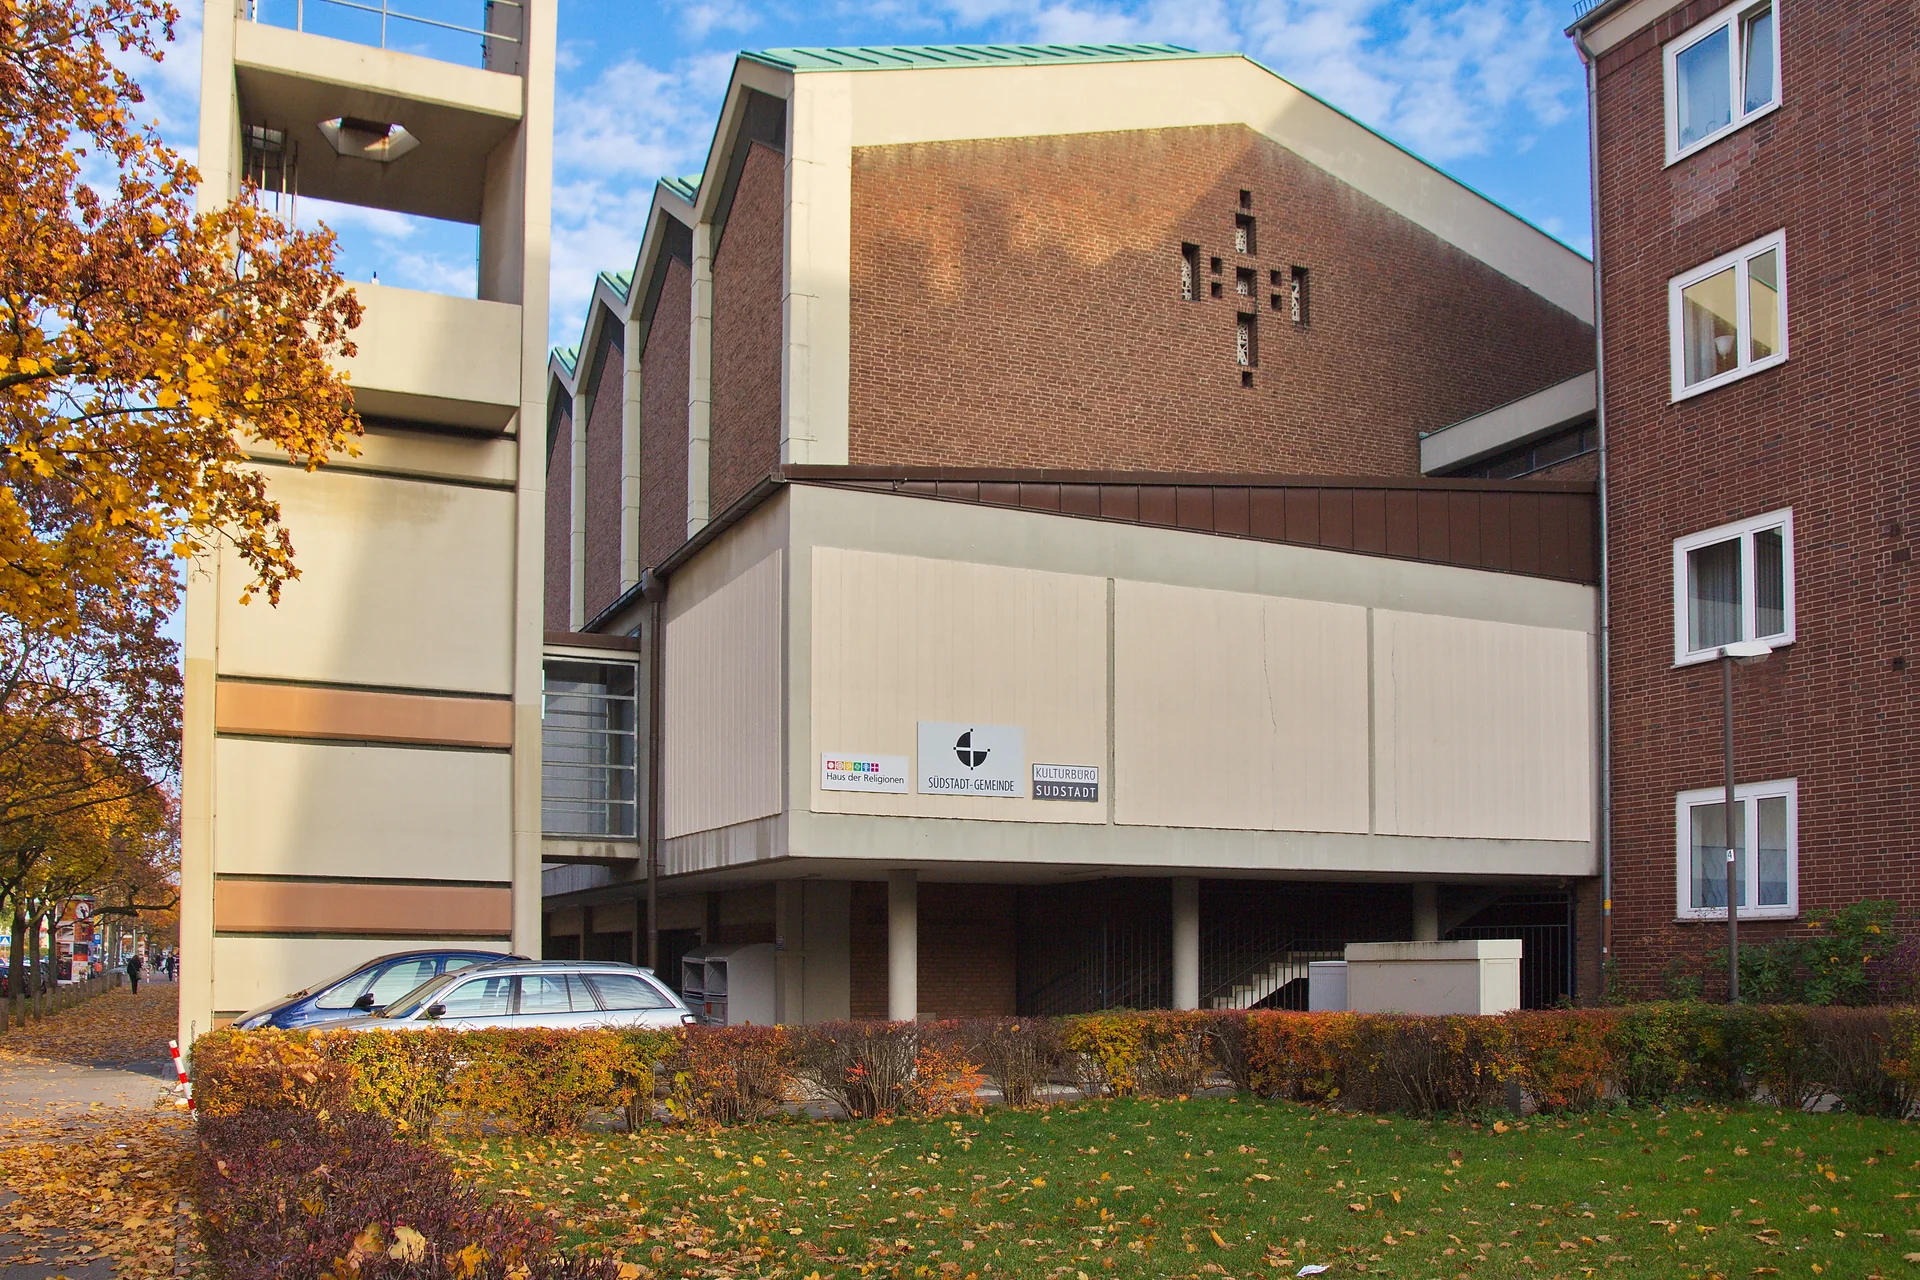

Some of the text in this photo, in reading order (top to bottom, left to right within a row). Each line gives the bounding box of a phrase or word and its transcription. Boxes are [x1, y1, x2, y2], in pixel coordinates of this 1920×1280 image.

[826, 772, 905, 785] Haus der Religionen
[928, 775, 1015, 792] SÜDSTADT-GEMEINDE
